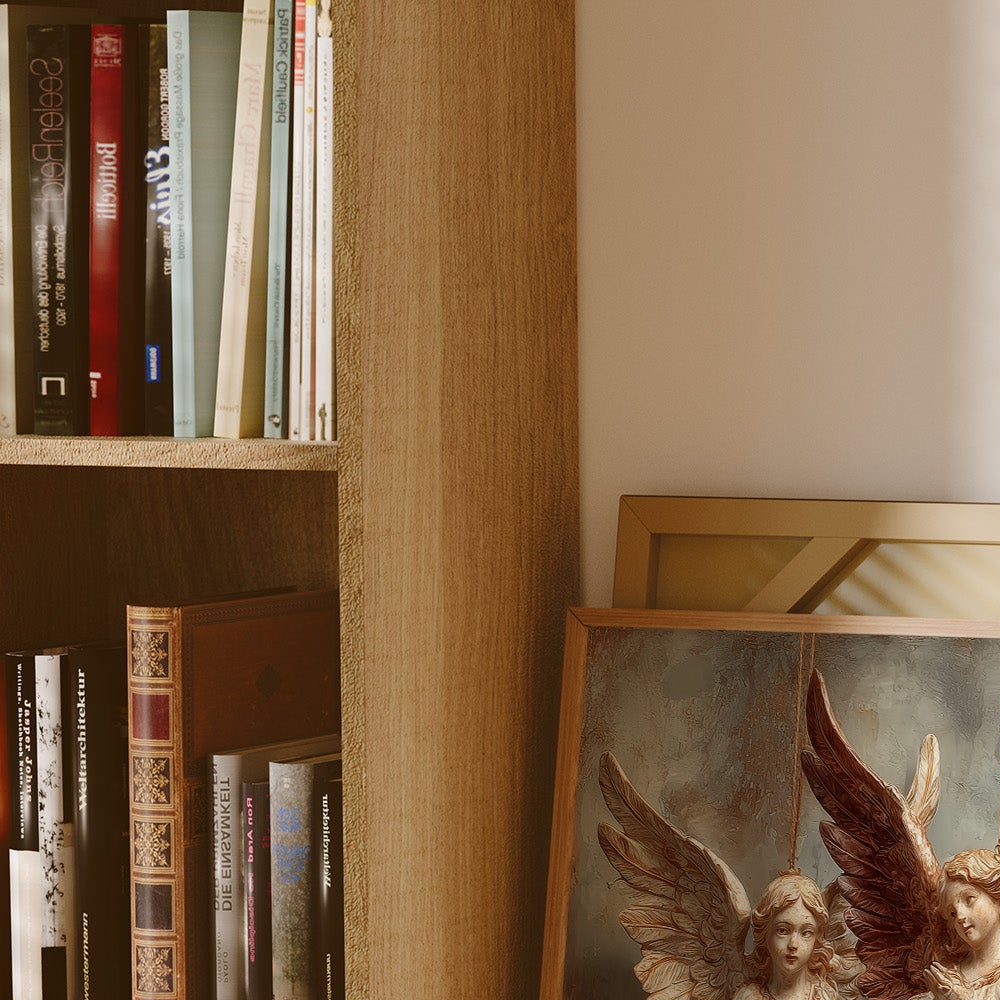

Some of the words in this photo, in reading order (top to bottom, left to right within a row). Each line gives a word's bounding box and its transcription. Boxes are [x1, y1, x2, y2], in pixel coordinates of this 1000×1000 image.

[22, 699, 32, 752] Jasper
[76, 668, 87, 810] Weltarchitektur
[24, 756, 32, 802] Johns
